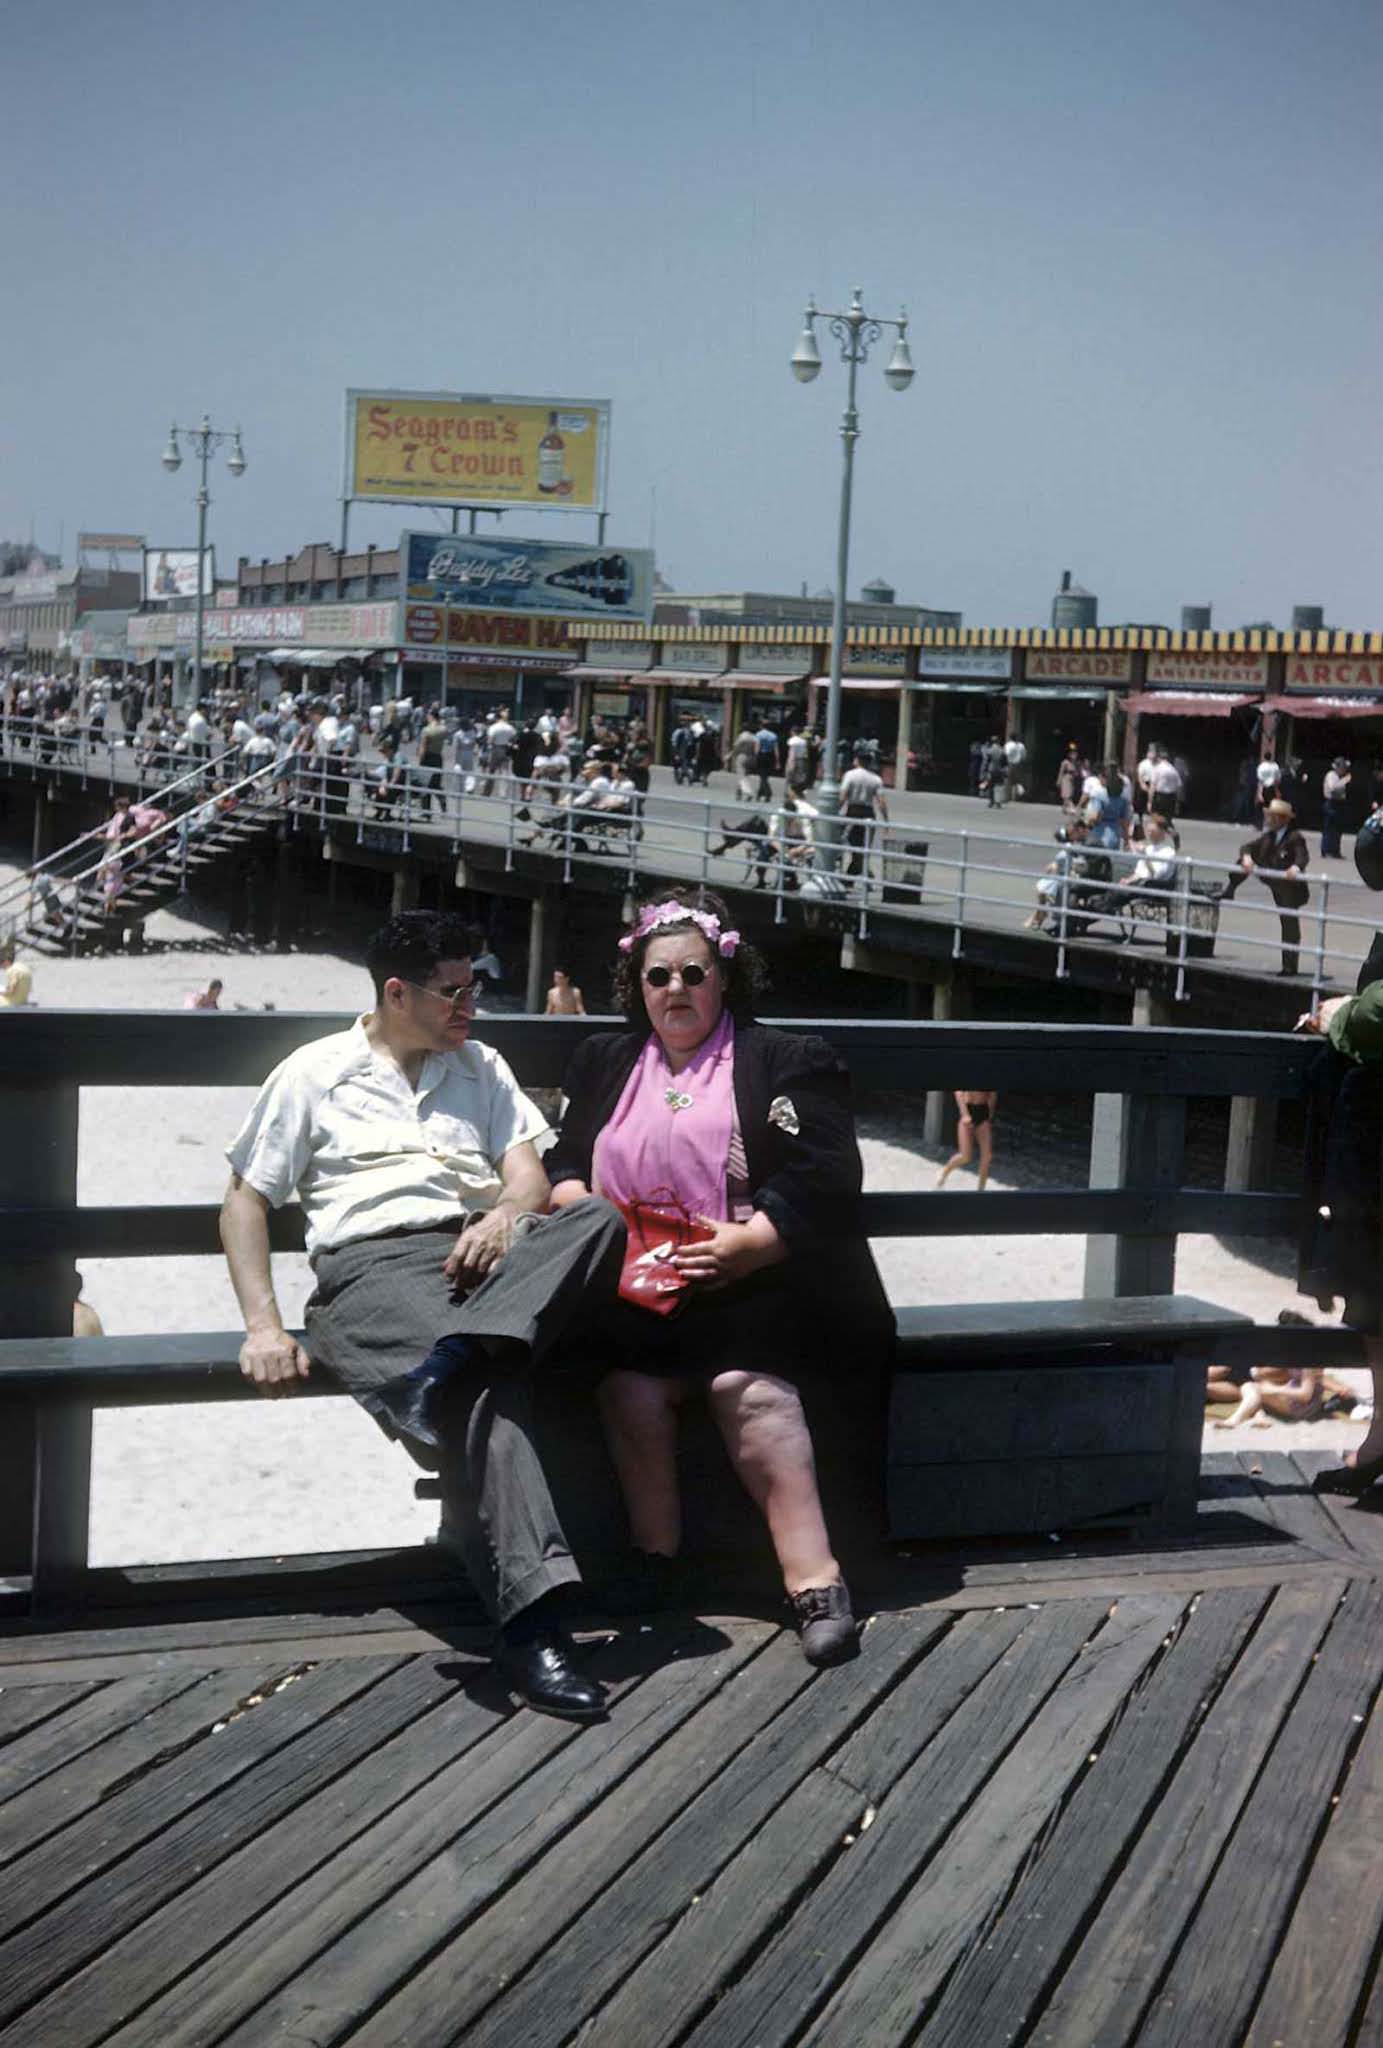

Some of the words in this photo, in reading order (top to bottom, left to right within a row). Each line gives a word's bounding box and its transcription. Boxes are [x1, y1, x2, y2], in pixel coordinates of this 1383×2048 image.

[367, 405, 519, 444] Seagram's
[402, 441, 420, 472] 7
[431, 446, 525, 476] Crown
[428, 547, 497, 588] Buddy
[1032, 656, 1129, 676] ARCADE
[1152, 668, 1264, 681] AMUSEMENTS
[1290, 664, 1383, 685] ARCA
